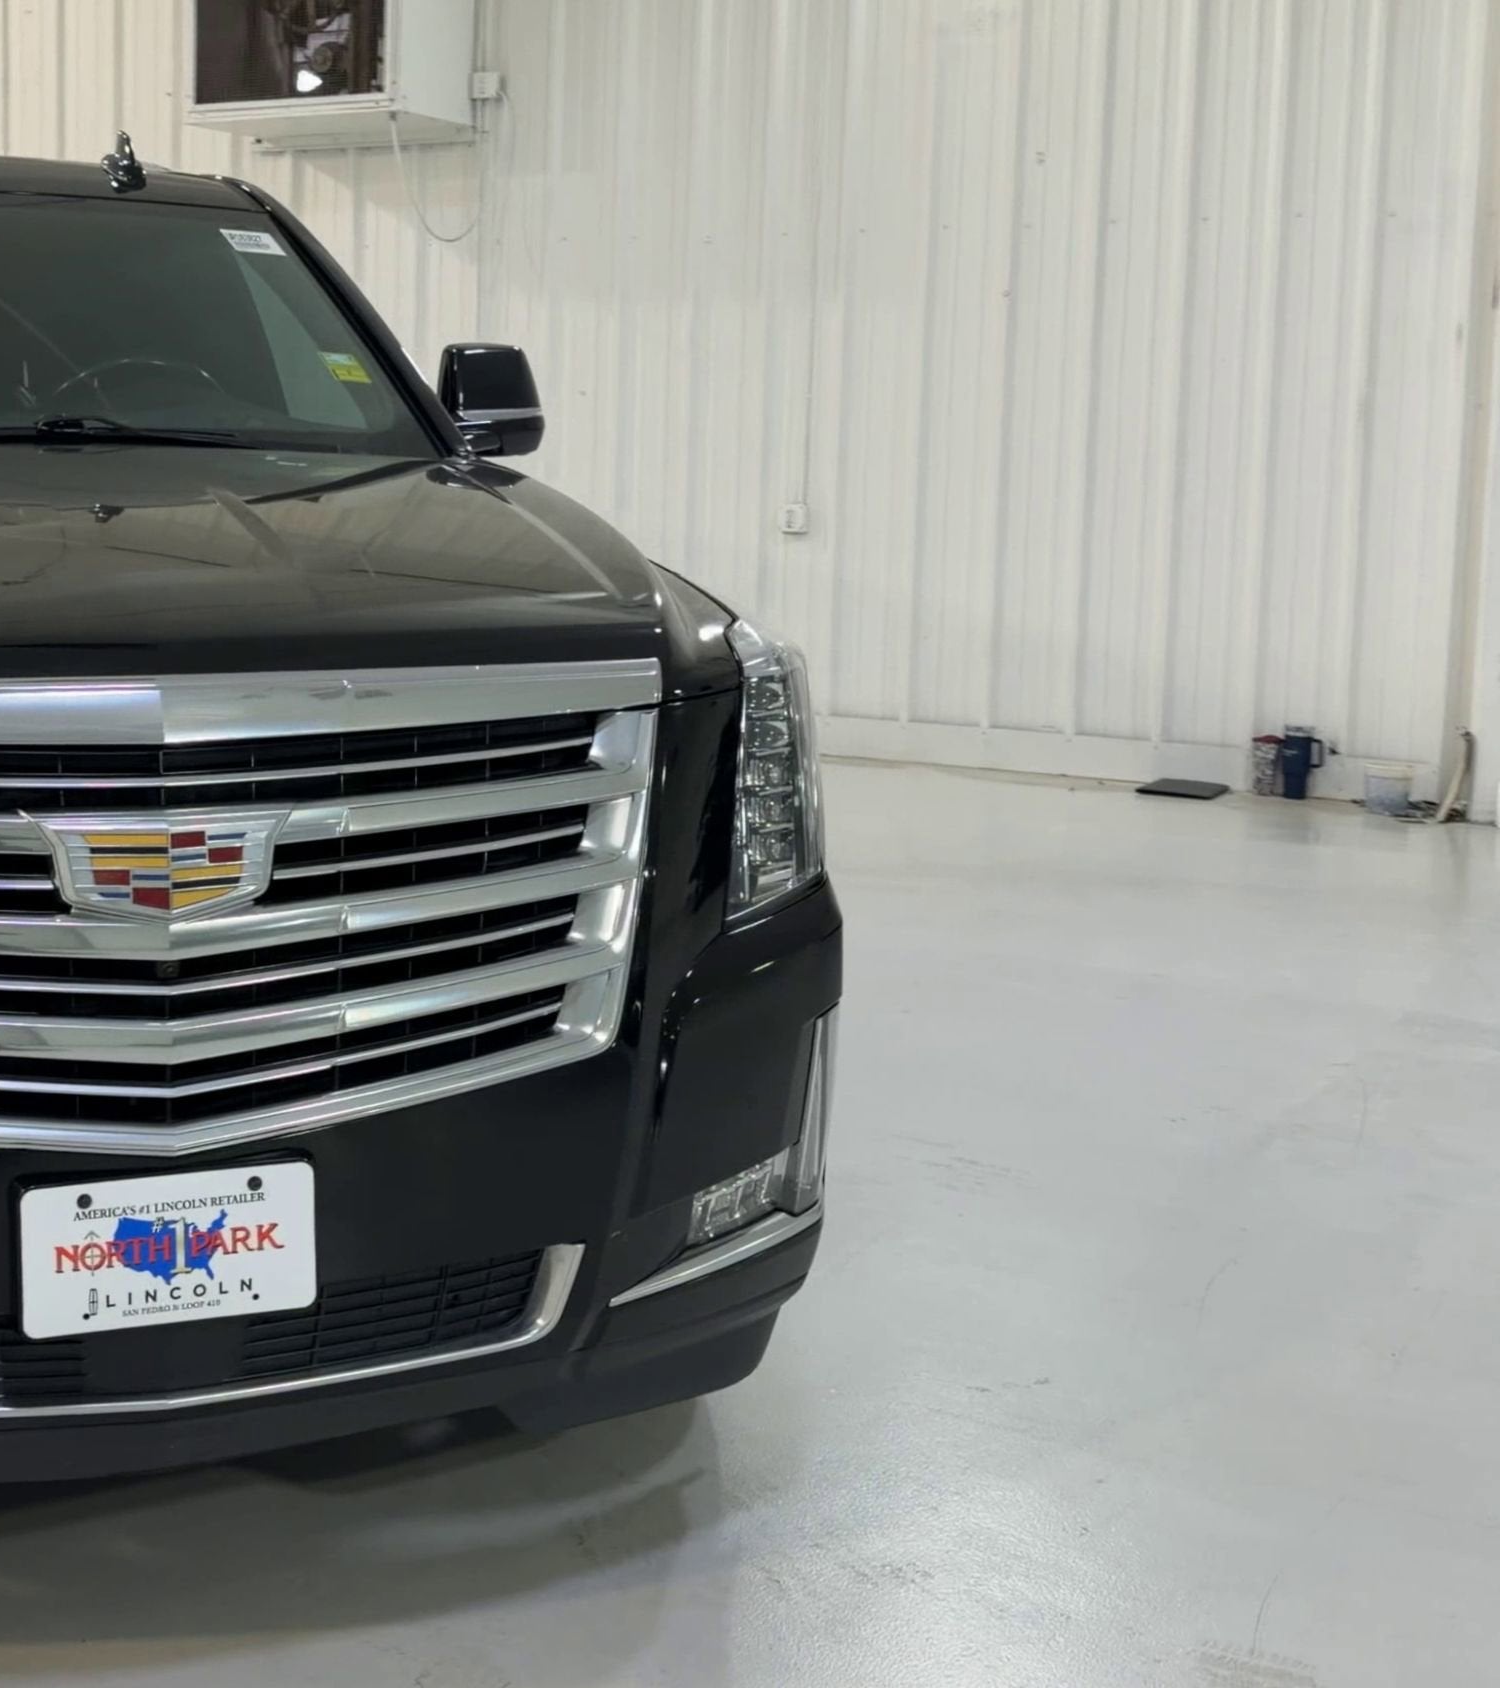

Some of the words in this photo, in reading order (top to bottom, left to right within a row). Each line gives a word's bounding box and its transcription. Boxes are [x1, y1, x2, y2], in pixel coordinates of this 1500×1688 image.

[73, 1205, 136, 1222] AMERICA'S
[154, 1198, 208, 1213] LINCOLN
[210, 1192, 266, 1206] RETAILER
[54, 1233, 172, 1274] NORTH
[190, 1223, 285, 1258] PARK
[105, 1278, 253, 1308] LINCOLN
